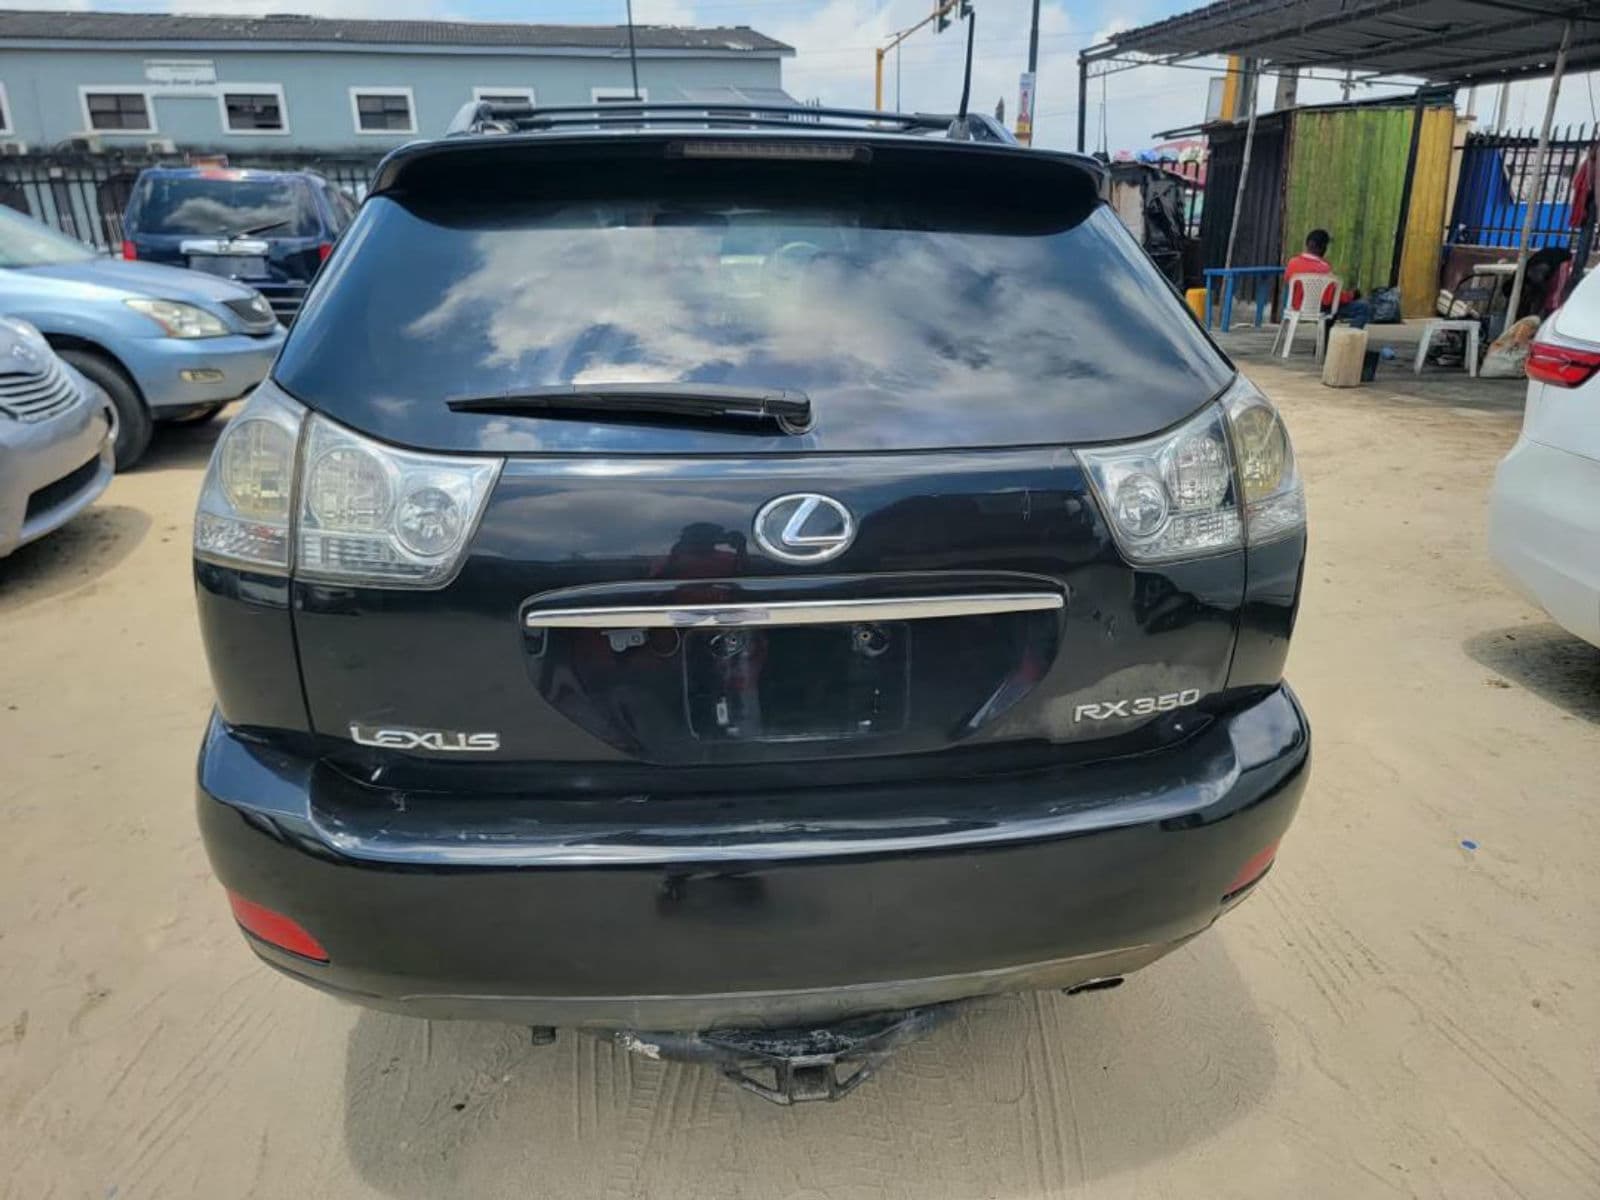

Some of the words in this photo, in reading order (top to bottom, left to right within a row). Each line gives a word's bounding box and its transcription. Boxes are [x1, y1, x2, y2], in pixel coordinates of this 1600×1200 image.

[1074, 700, 1129, 722] RX
[1131, 688, 1200, 715] 350
[350, 726, 500, 751] LEXUS
